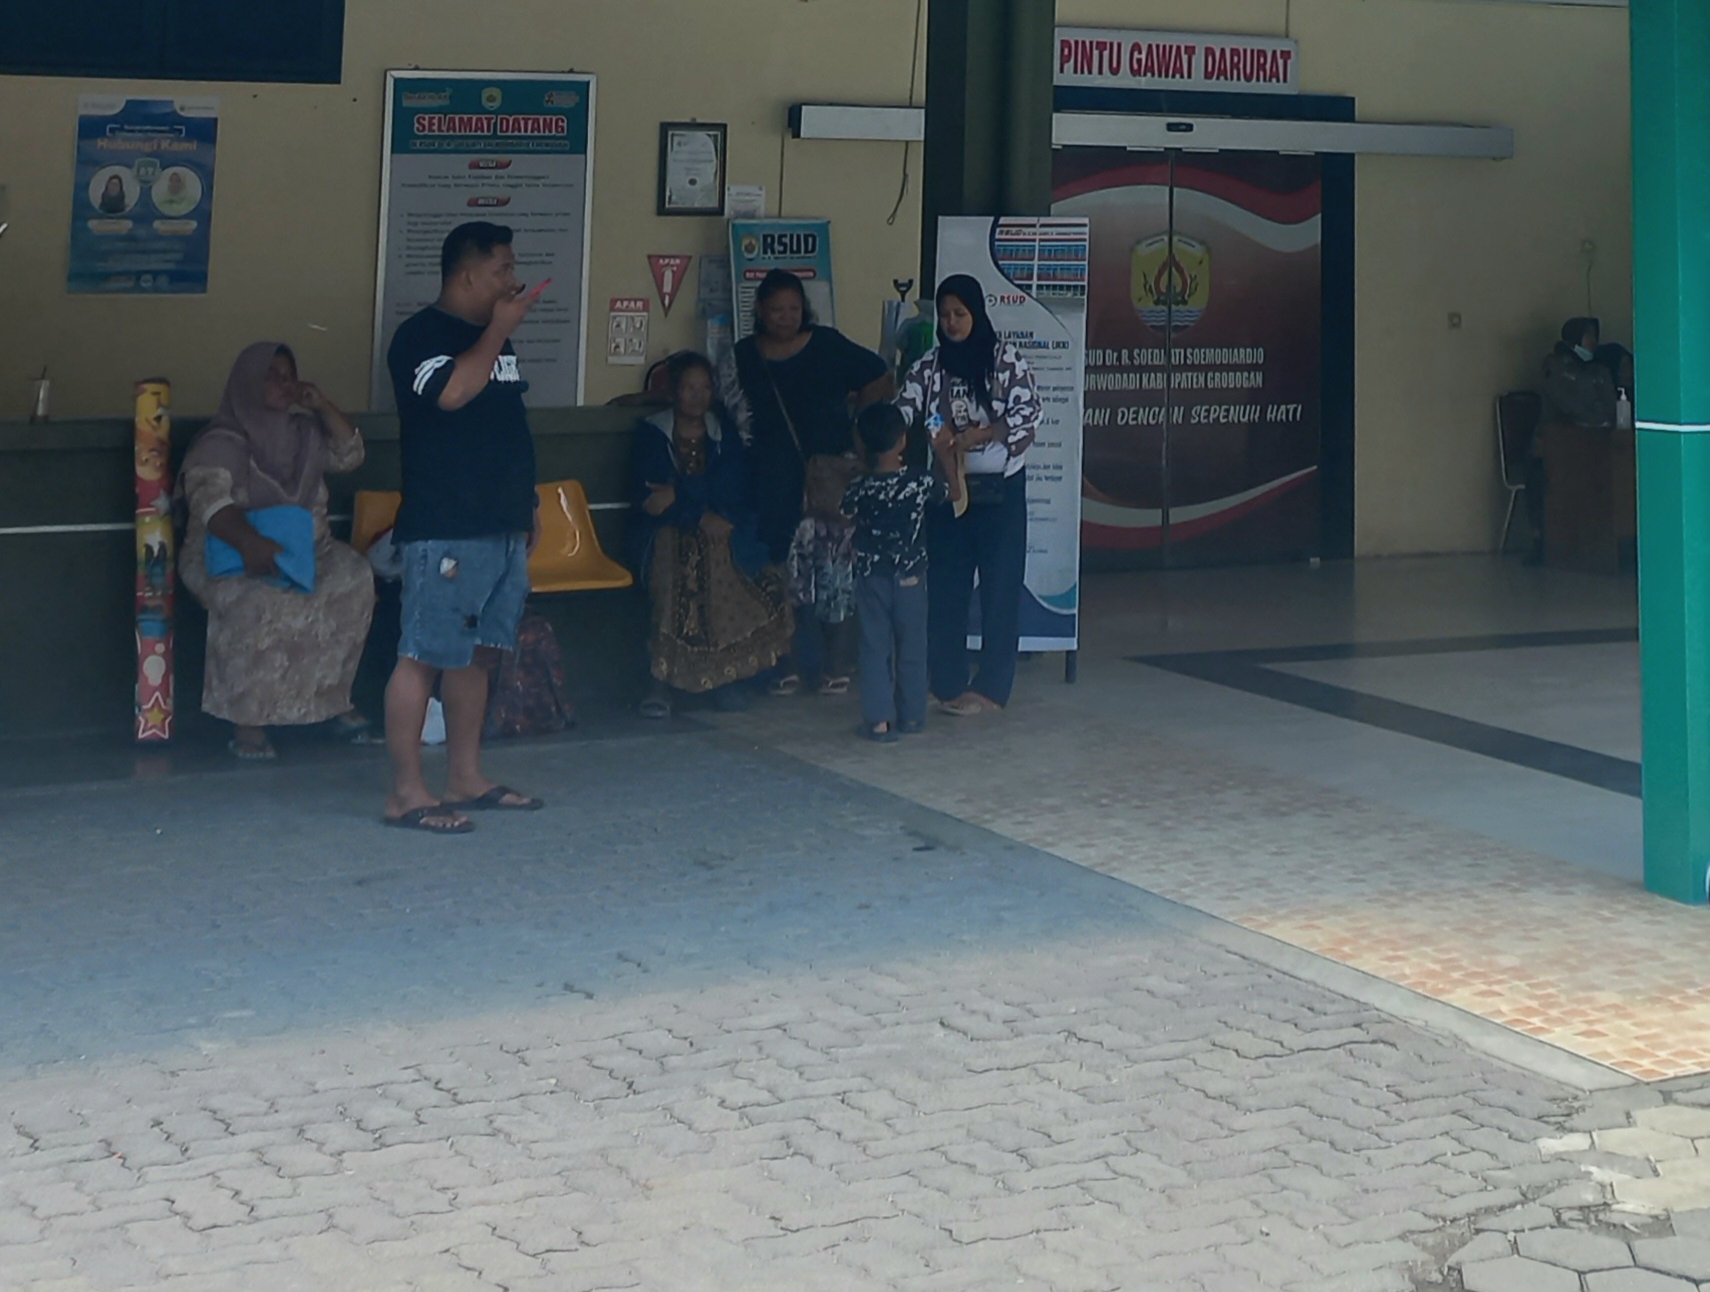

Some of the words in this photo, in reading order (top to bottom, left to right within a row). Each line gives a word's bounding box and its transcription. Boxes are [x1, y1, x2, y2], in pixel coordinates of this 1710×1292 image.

[1059, 39, 1123, 76] PINTU
[1129, 41, 1197, 80] GAWAT
[1203, 46, 1292, 84] DARURAT
[414, 114, 496, 136] SELAMAT
[497, 115, 568, 137] DATANG
[761, 233, 818, 255] RSUD
[614, 300, 644, 311] APAR
[999, 295, 1026, 304] RSUD
[1084, 349, 1104, 366] SUD
[1105, 348, 1120, 366] Dr.
[1186, 347, 1265, 365] SOEMODIARDJO
[1084, 373, 1140, 391] URWODADI
[1141, 371, 1206, 390] KABUPATEN
[1207, 371, 1263, 389] GROBOGAN
[1117, 405, 1185, 426] DENGAN
[1190, 404, 1262, 425] SEPENUH
[1266, 403, 1303, 423] HATI
